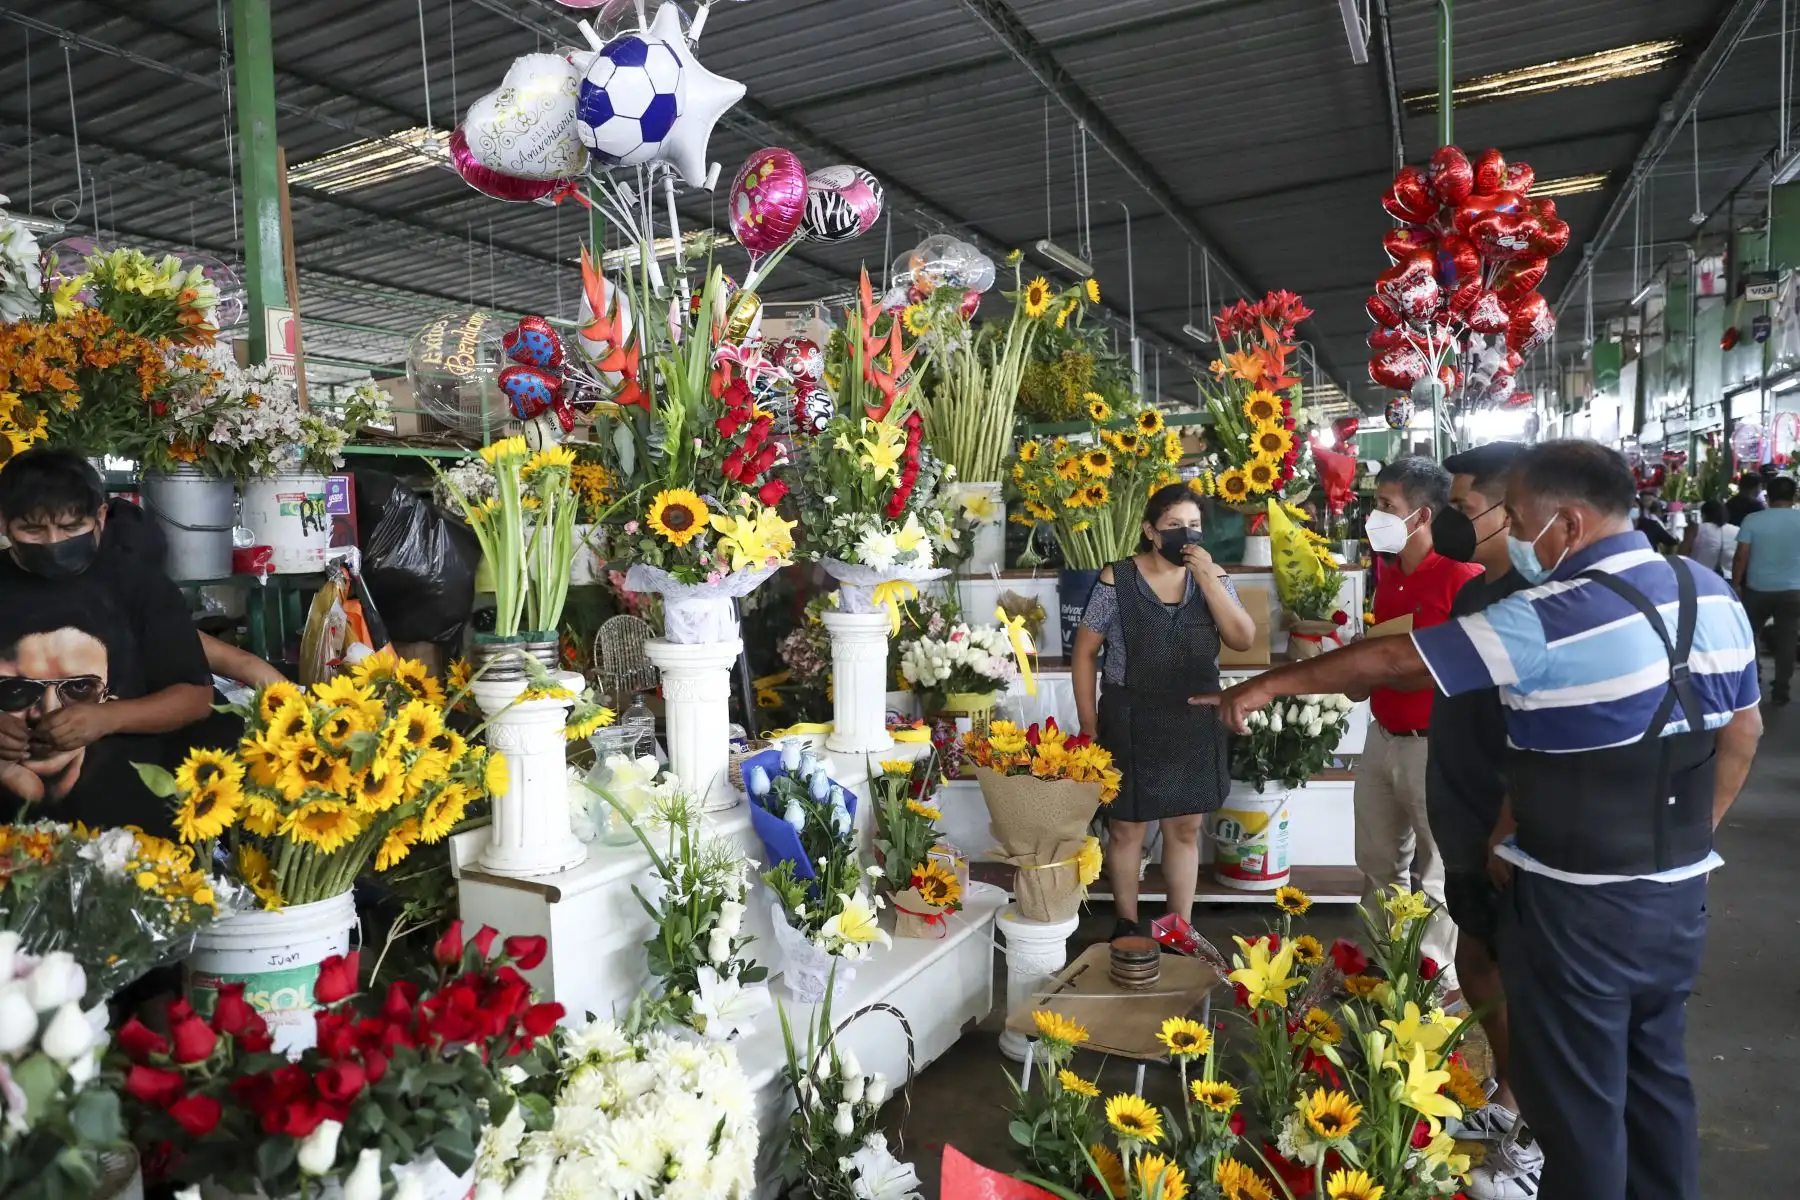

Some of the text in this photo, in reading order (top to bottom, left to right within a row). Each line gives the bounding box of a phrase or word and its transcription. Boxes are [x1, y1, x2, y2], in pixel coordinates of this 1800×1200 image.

[511, 109, 575, 170] Aniversario
[1751, 286, 1774, 295] VISA
[267, 952, 300, 966] Juan
